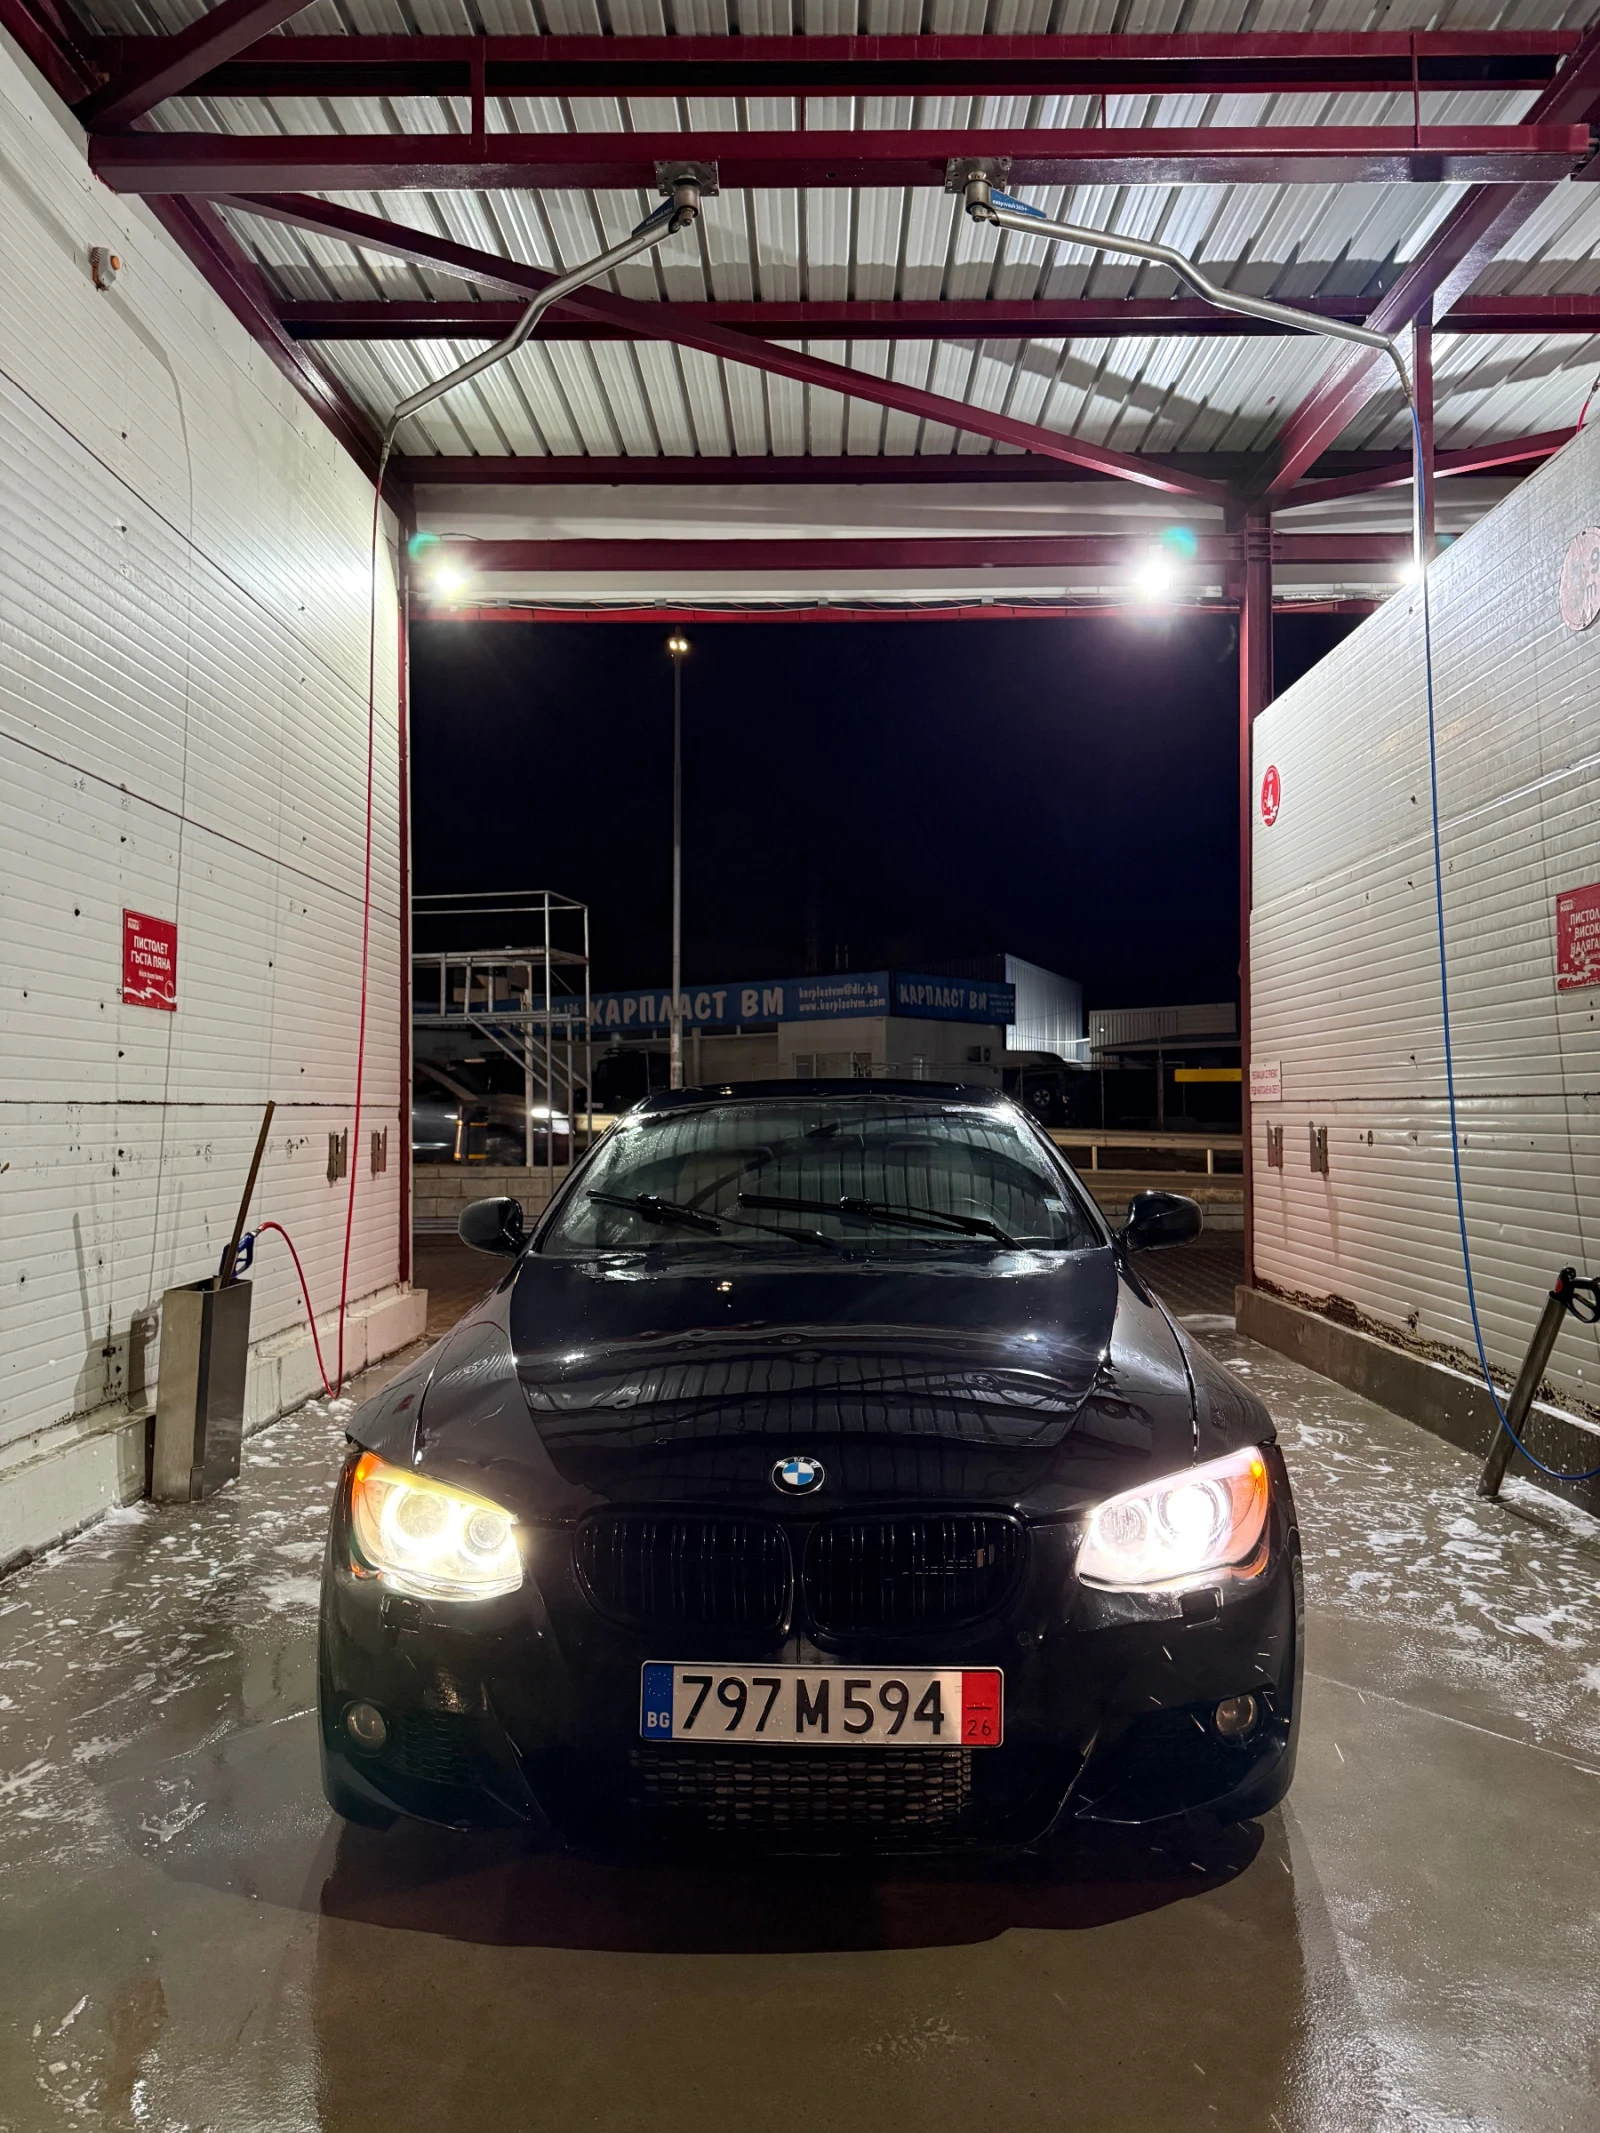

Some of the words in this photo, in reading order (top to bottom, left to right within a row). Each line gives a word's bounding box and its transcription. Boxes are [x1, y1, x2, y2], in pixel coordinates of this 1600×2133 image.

[1570, 907, 1600, 926] ПИСТОЛ
[1574, 922, 1600, 939] ВИСОК
[133, 935, 168, 955] ПИСТОЛЕТ
[1570, 937, 1600, 956] НАЛЯГА
[130, 950, 152, 967] ГЪСТА
[152, 955, 171, 971] ПЯНА
[799, 982, 878, 1000] karplastvm@dir.bg
[900, 983, 965, 1009] КАРПЛАСТ
[969, 990, 987, 1011] ВМ
[590, 990, 727, 1026] КАРПЛАСТ
[741, 987, 784, 1018] ВМ
[799, 997, 886, 1012] www.karplastvm.com
[682, 1675, 782, 1733] 797
[843, 1679, 945, 1736] 594
[647, 1711, 670, 1728] BG
[967, 1719, 992, 1737] 26
